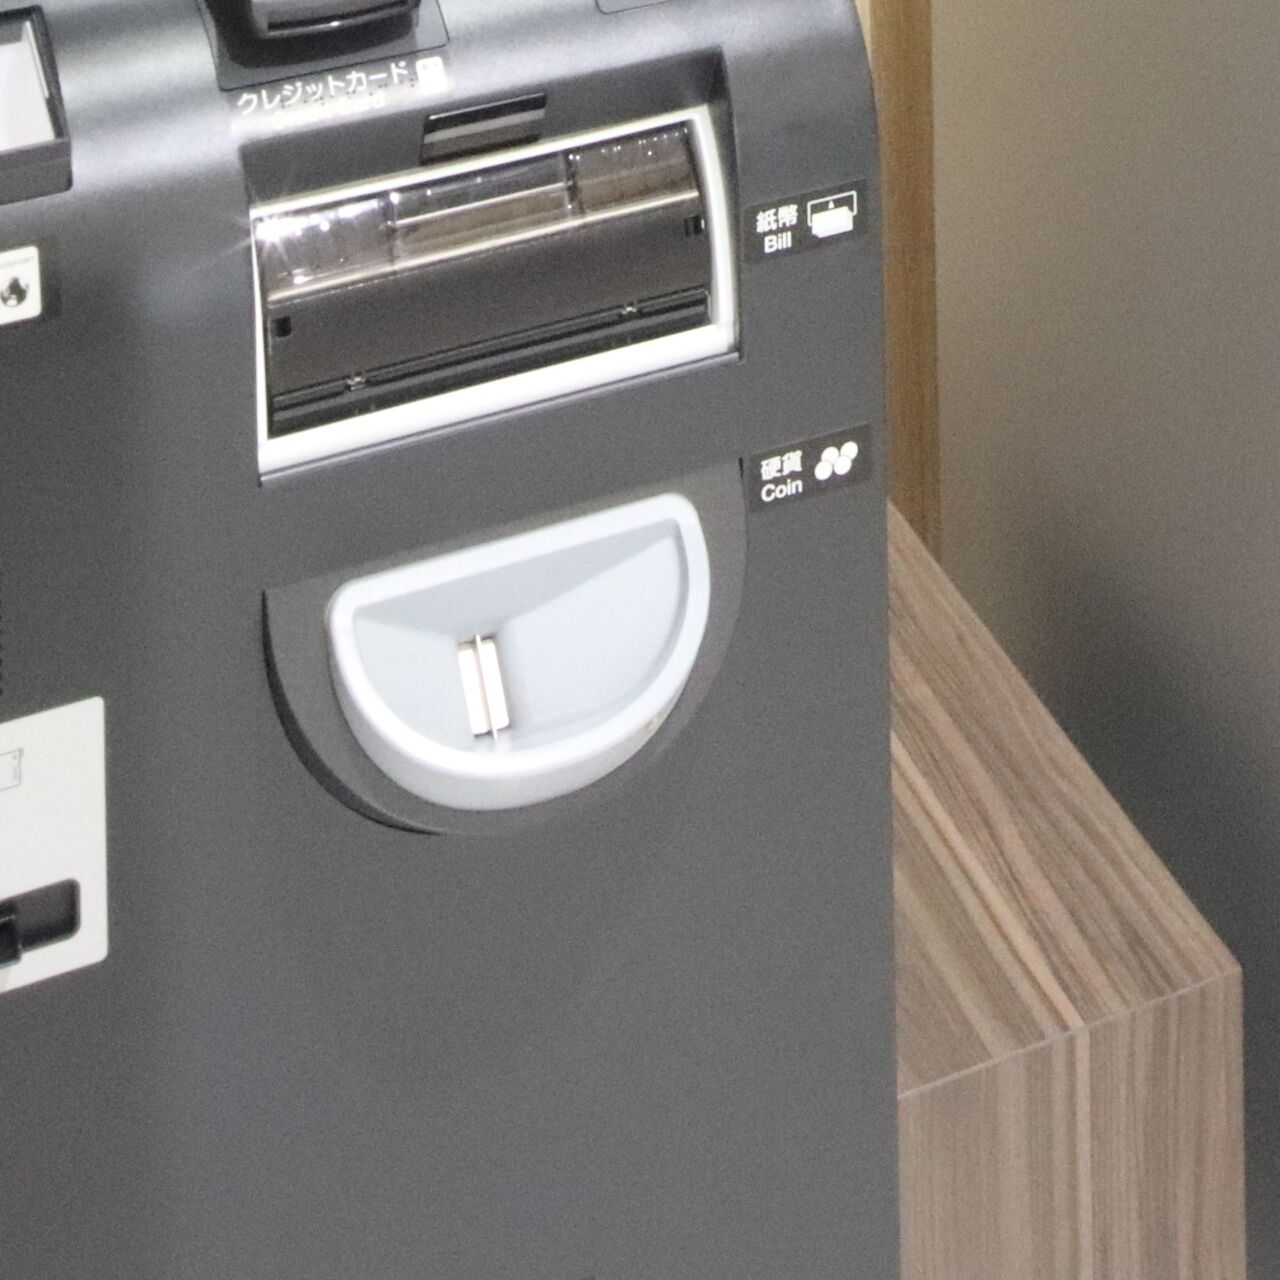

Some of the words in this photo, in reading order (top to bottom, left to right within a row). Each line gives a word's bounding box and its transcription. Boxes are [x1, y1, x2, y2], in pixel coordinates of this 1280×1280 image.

[237, 60, 409, 115] クレジットカード
[755, 203, 799, 234] 紙幣
[763, 231, 793, 254] Bill
[760, 450, 803, 481] 硬貨
[760, 478, 803, 503] Coin
